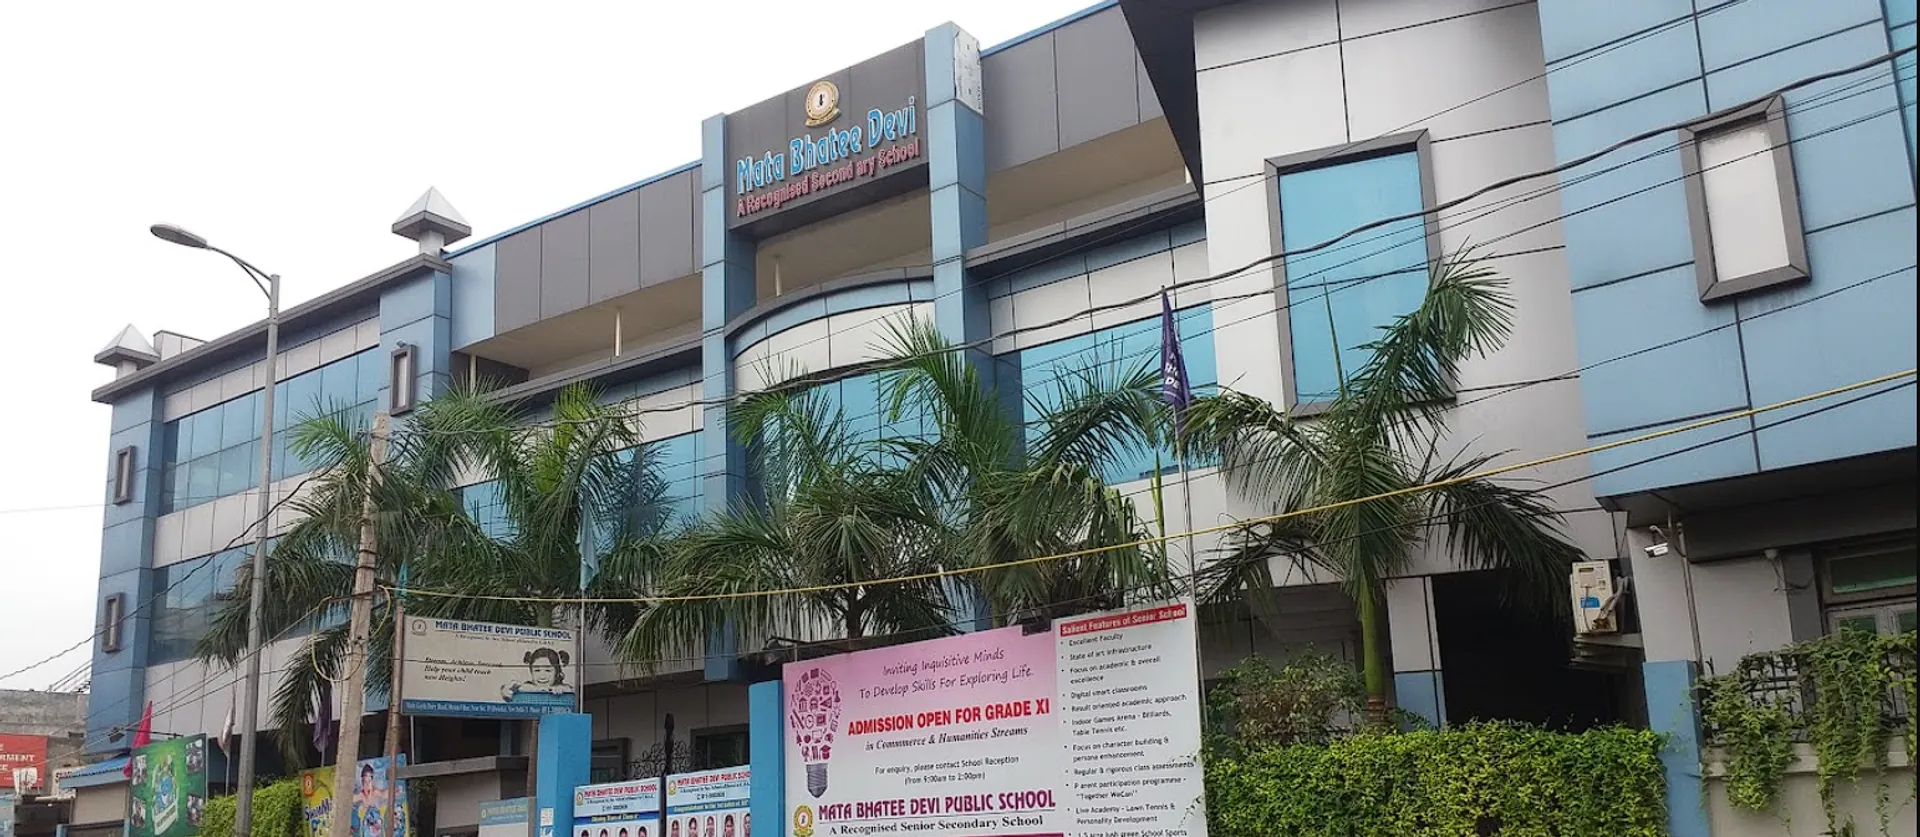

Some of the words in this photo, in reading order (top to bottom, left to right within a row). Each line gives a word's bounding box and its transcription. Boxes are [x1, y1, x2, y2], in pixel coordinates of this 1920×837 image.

[736, 151, 784, 195] Mata
[790, 125, 862, 176] Bhatee
[867, 95, 916, 148] Devi
[737, 199, 746, 217] A
[746, 175, 810, 213] Recognised
[878, 138, 921, 168] School
[1089, 619, 1120, 631] Features
[1122, 617, 1130, 625] of
[1132, 613, 1156, 624] Senior
[1159, 607, 1185, 618] School
[435, 621, 458, 630] MATA
[461, 623, 492, 633] BHATEE
[495, 625, 514, 635] DEVI
[515, 627, 541, 637] PUBLIC
[543, 630, 572, 640] SCHOOL
[1069, 637, 1098, 646] Excellent
[1070, 652, 1085, 661] State
[1107, 643, 1152, 655] infrastructure
[883, 661, 918, 676] Inviting
[921, 654, 970, 673] Inquisitive
[973, 647, 1005, 662] Minds
[1099, 660, 1129, 670] academic
[1138, 656, 1161, 665] overall
[859, 688, 870, 699] To
[873, 683, 909, 698] Develop
[912, 679, 936, 692] Skills
[939, 677, 957, 689] For
[959, 669, 1008, 688] Exploring
[1070, 674, 1104, 684] excellence
[1071, 690, 1091, 699] Digital
[1092, 688, 1110, 696] smart
[1112, 684, 1147, 694] classrooms
[1071, 703, 1091, 712] Result
[1092, 700, 1120, 710] oriented
[1122, 698, 1153, 707] academic
[1154, 694, 1187, 704] approach
[848, 714, 914, 736] ADMISSION
[917, 709, 951, 728] OPEN
[955, 705, 982, 724] FOR
[985, 700, 1032, 720] GRADE
[1036, 698, 1050, 715] XI
[1071, 718, 1091, 726] Indoor
[1093, 715, 1115, 723] Games
[1116, 713, 1136, 721] Arena
[865, 740, 874, 751] in
[928, 734, 936, 744] &
[938, 729, 989, 745] Humanities
[990, 725, 1028, 739] Streams
[1072, 744, 1091, 752] Focus
[1102, 740, 1133, 749] character
[1135, 737, 1162, 747] building
[874, 766, 885, 775] For
[913, 763, 934, 773] please
[935, 760, 960, 770] contact
[961, 758, 983, 768] School
[985, 755, 1019, 766] Reception
[1074, 768, 1098, 777] Regular
[1106, 766, 1132, 775] rigorous
[1134, 764, 1150, 772] class
[1152, 761, 1194, 771] assessments
[948, 773, 956, 781] to
[1099, 779, 1140, 789] participation
[1142, 776, 1182, 786] programme
[818, 804, 851, 821] MATA
[856, 799, 905, 819] BHATEE
[910, 797, 940, 815] DEVI
[945, 793, 994, 813] PUBLIC
[999, 789, 1056, 811] SCHOOL
[1091, 806, 1120, 814] Academy
[828, 826, 837, 836] A
[840, 822, 898, 836] Recognised
[900, 820, 937, 831] Senior
[940, 817, 999, 832] Secondary
[1002, 814, 1043, 828] School
[1077, 816, 1112, 826] Personality
[1113, 815, 1158, 824] Development
